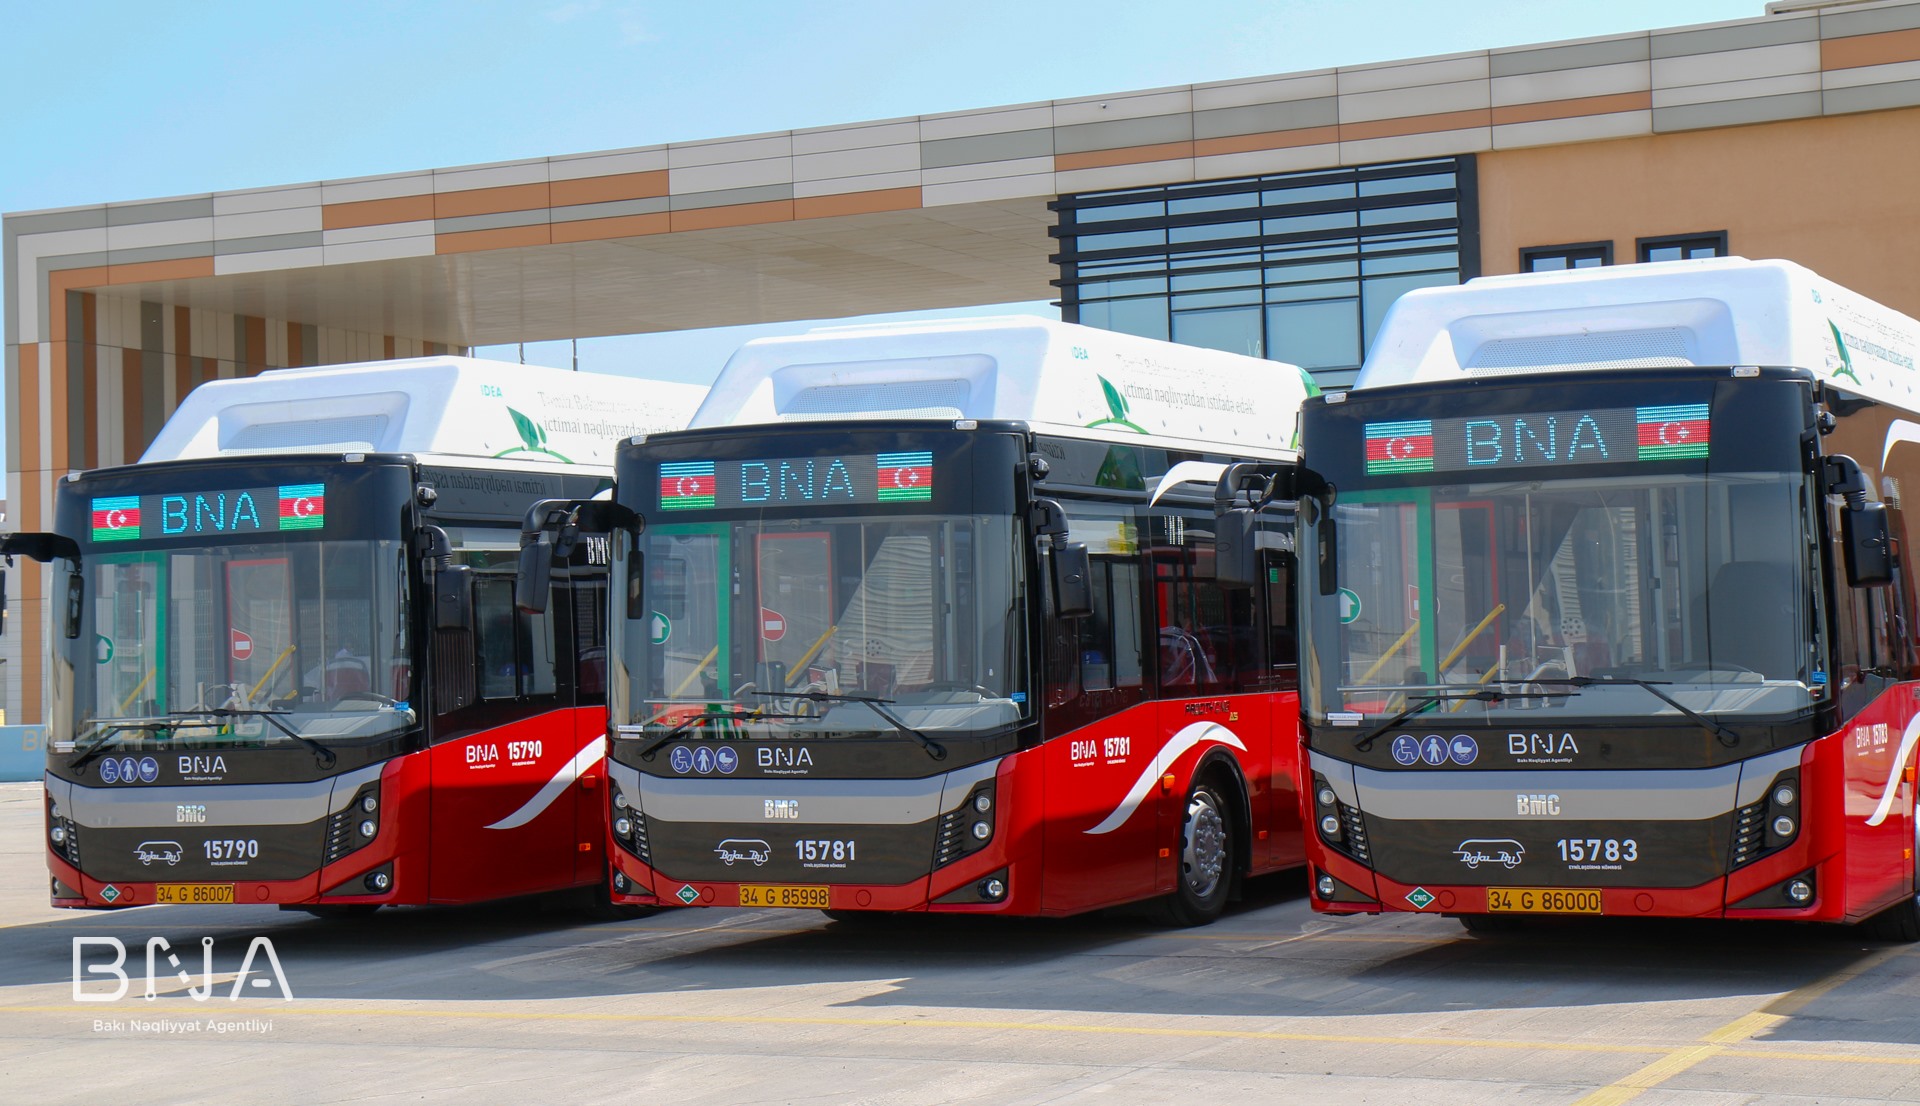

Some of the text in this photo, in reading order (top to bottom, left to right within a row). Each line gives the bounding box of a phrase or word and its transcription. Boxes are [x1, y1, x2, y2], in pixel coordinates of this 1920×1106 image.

[1465, 414, 1609, 466] BNA
[741, 459, 855, 502] BNA
[162, 491, 261, 534] BNA
[466, 740, 542, 763] BNA 15790
[1071, 736, 1131, 761] BNA 15781
[1508, 733, 1579, 755] BNA
[178, 755, 227, 774] BNA
[757, 747, 813, 767] BNA
[176, 805, 206, 823] BMC
[764, 799, 799, 819] BMC
[1516, 793, 1561, 816] BMC
[203, 839, 259, 859] 15790
[795, 840, 855, 861] 15781
[1556, 838, 1638, 862] 15783
[158, 886, 232, 901] 34 G 86007
[741, 888, 828, 905] 34 G 85998
[1413, 894, 1428, 902] CNG
[1490, 891, 1599, 911] 34 G 86000
